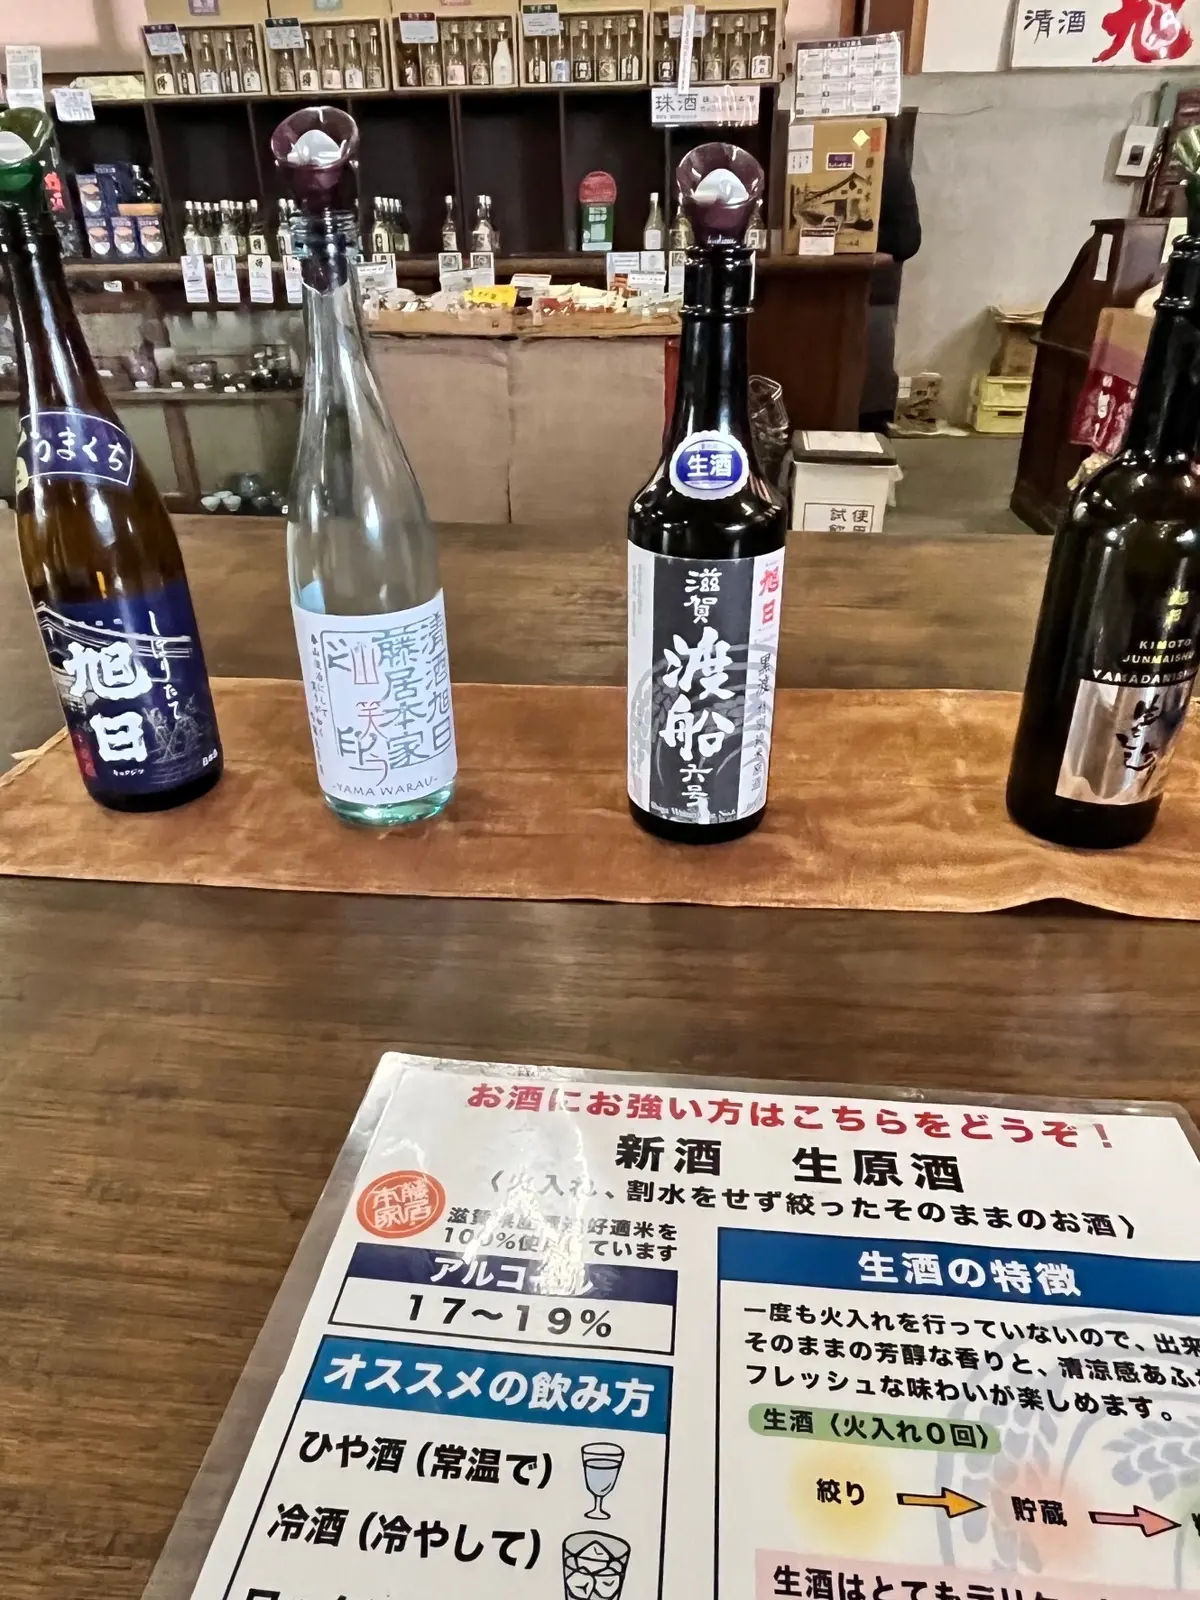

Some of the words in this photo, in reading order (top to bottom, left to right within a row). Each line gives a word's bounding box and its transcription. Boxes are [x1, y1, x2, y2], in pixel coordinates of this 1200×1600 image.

[1023, 9, 1088, 44] 清酒
[687, 453, 733, 477] 生酒
[684, 568, 722, 623] 滋賀
[759, 566, 779, 625] 旭日
[1139, 639, 1192, 650] KIMOTO
[63, 641, 153, 763] 旭日
[659, 626, 735, 761] 渡船
[615, 1134, 723, 1177] 新酒
[791, 1146, 965, 1193] 生原酒
[858, 1250, 1082, 1297] 生酒の特徴
[323, 1353, 655, 1418] オススメの飲み方
[744, 1332, 1200, 1388] そのままの芳醇な香りと、清涼感あふ
[746, 1365, 1173, 1422] フレッシュな味わいが楽しめます。
[816, 1478, 866, 1507] 絞り
[1010, 1496, 1067, 1528] 貯蔵
